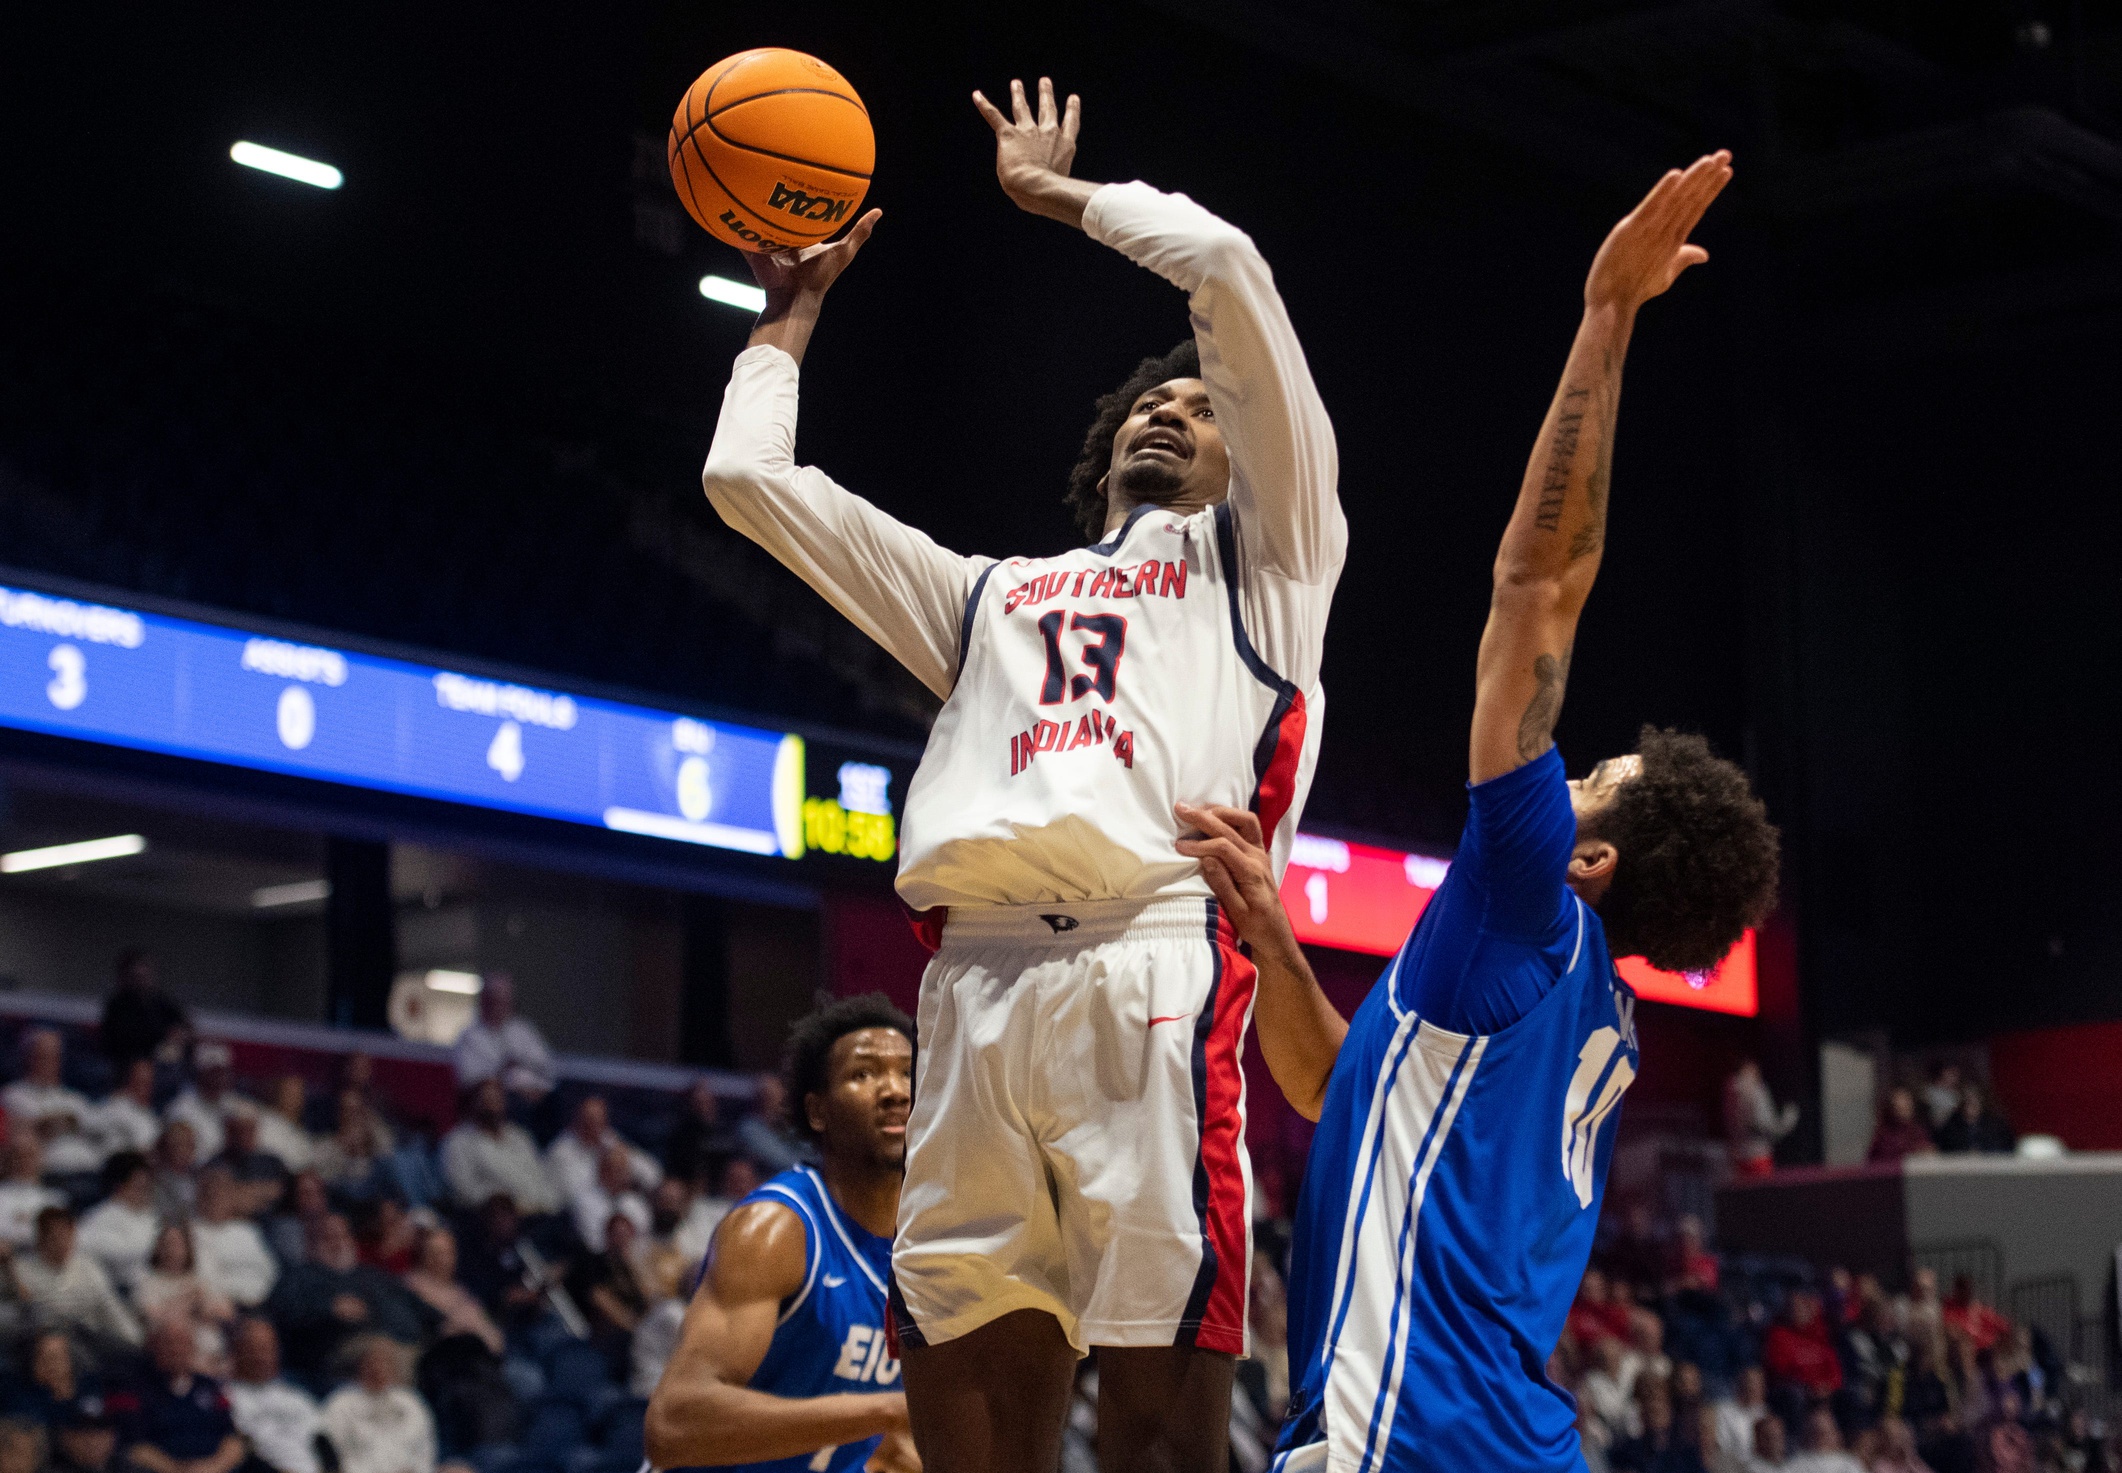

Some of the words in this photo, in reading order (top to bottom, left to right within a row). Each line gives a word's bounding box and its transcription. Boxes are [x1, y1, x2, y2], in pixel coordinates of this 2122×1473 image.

[766, 181, 854, 222] NCAA
[1004, 559, 1187, 615] SOUTHERN
[47, 643, 88, 710] 3
[1037, 609, 1127, 705] 13
[277, 685, 315, 749] 0
[1010, 708, 1133, 777] INDIANA
[487, 720, 524, 782] 4
[1305, 871, 1328, 924] 1
[1562, 1025, 1636, 1210] 10
